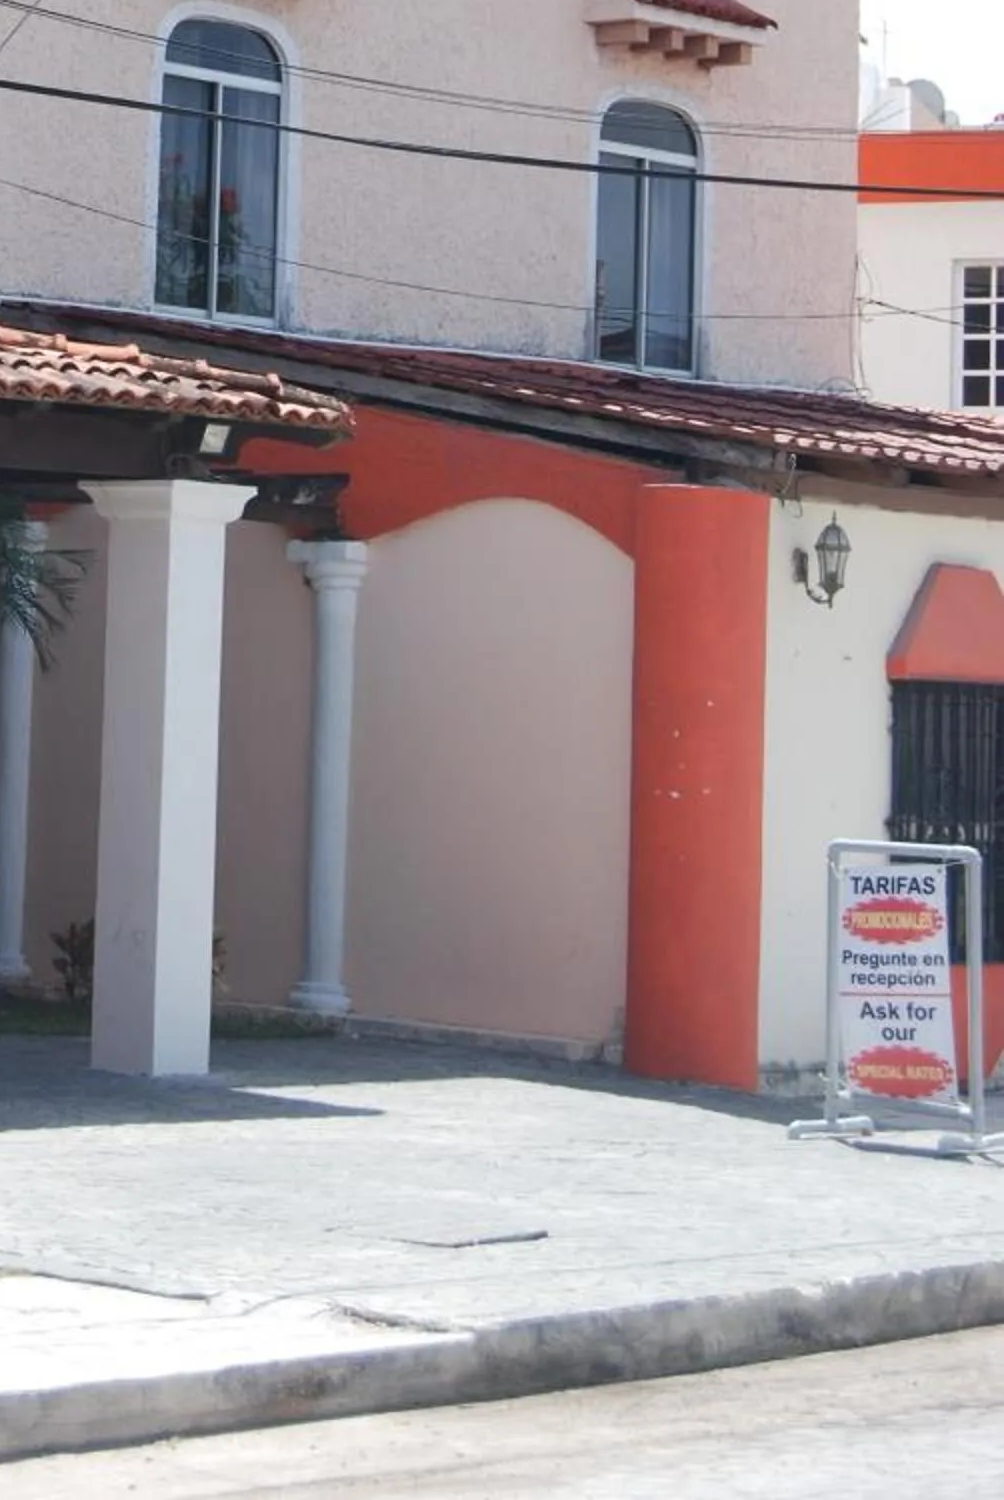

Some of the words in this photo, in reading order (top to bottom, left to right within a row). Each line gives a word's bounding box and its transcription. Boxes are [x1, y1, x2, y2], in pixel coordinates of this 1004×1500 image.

[850, 875, 936, 895] TARIFAS
[842, 949, 917, 969] Pregunte
[922, 954, 945, 966] en
[851, 970, 936, 988] recepción
[860, 1001, 900, 1020] Ask
[906, 1002, 938, 1021] for
[881, 1026, 917, 1041] our
